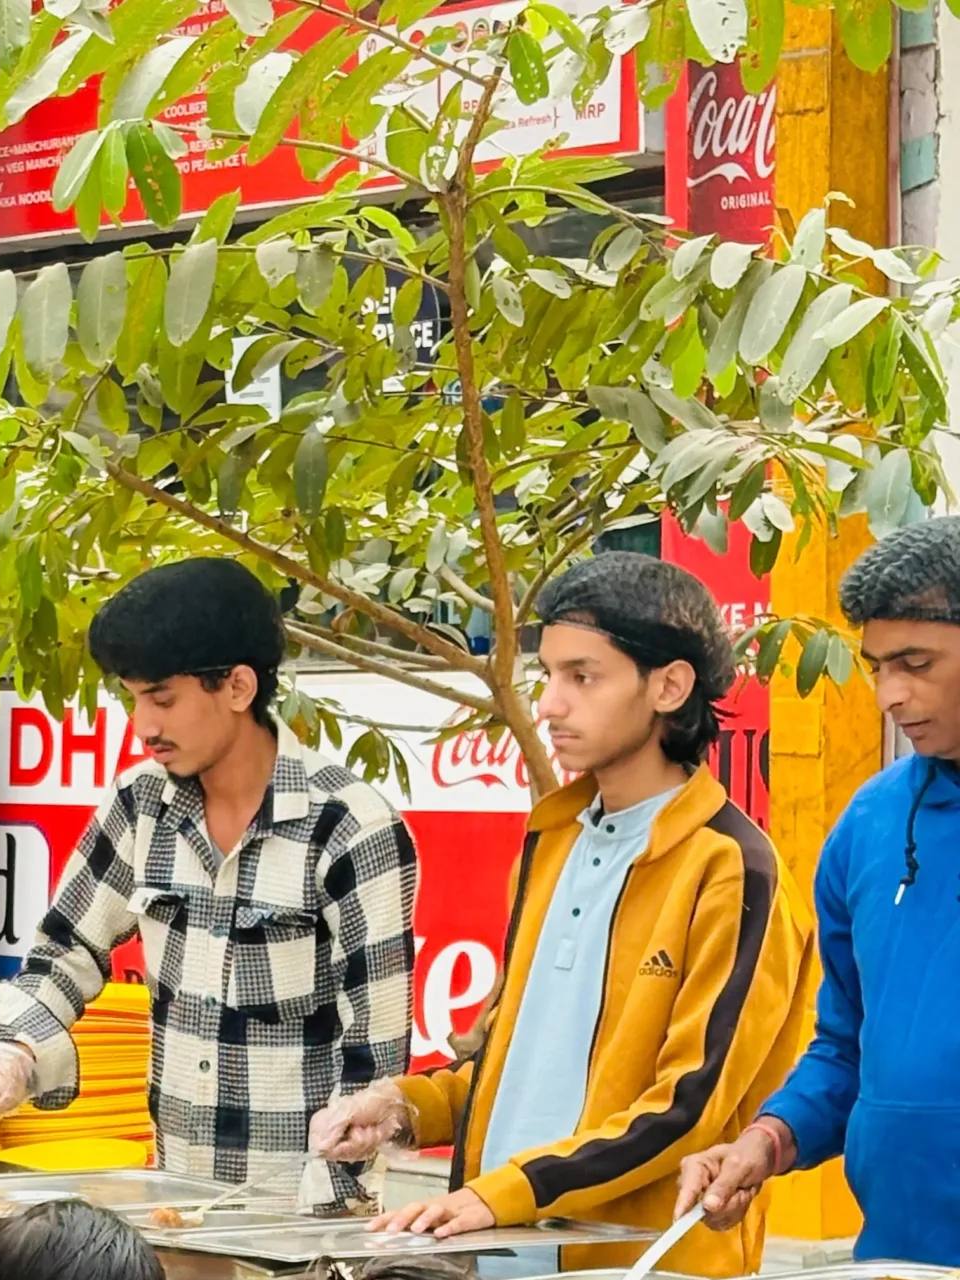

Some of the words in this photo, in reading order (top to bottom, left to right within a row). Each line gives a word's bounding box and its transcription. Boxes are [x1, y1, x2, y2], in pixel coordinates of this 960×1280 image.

[164, 101, 207, 119] COOLBER
[18, 189, 53, 204] NOODL
[720, 191, 772, 210] ORIGINAL
